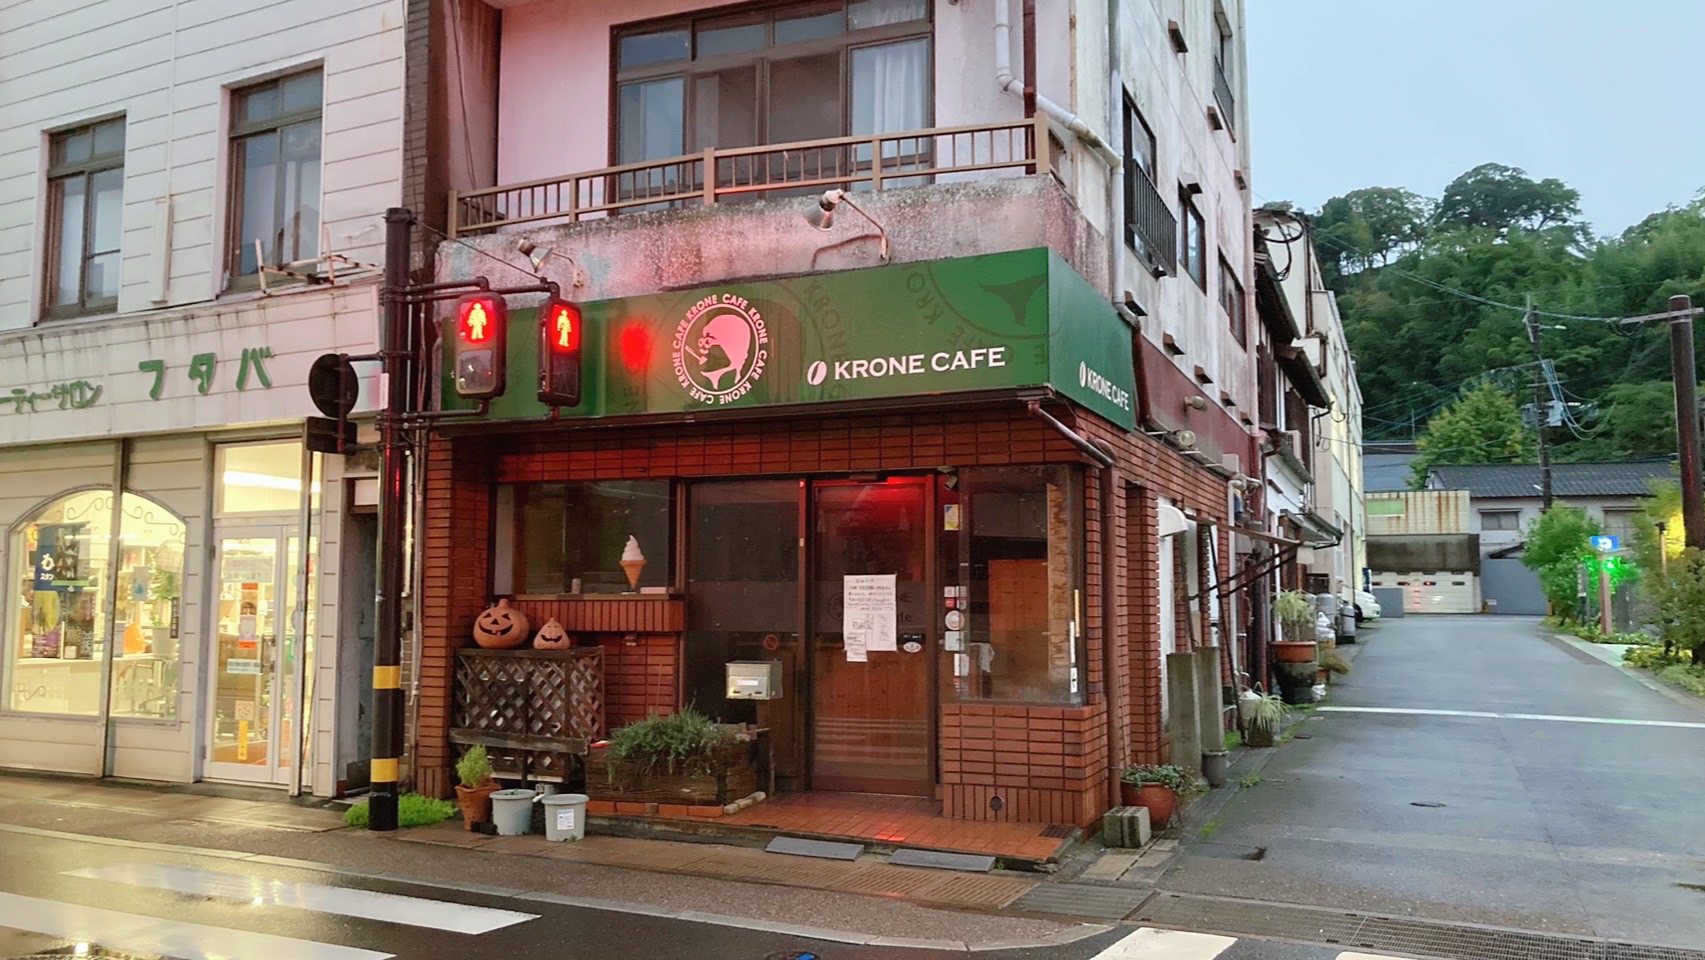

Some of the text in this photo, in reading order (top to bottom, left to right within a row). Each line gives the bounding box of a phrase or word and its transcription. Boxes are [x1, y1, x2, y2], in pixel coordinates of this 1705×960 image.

[139, 346, 275, 399] フタバ
[672, 293, 769, 405] KRONE CAFE KRONE CAFE KRONE CAFE KRONE CAFE
[834, 354, 925, 381] KRONE
[931, 347, 1006, 372] CAFE
[1087, 367, 1129, 412] KRONE CAFE
